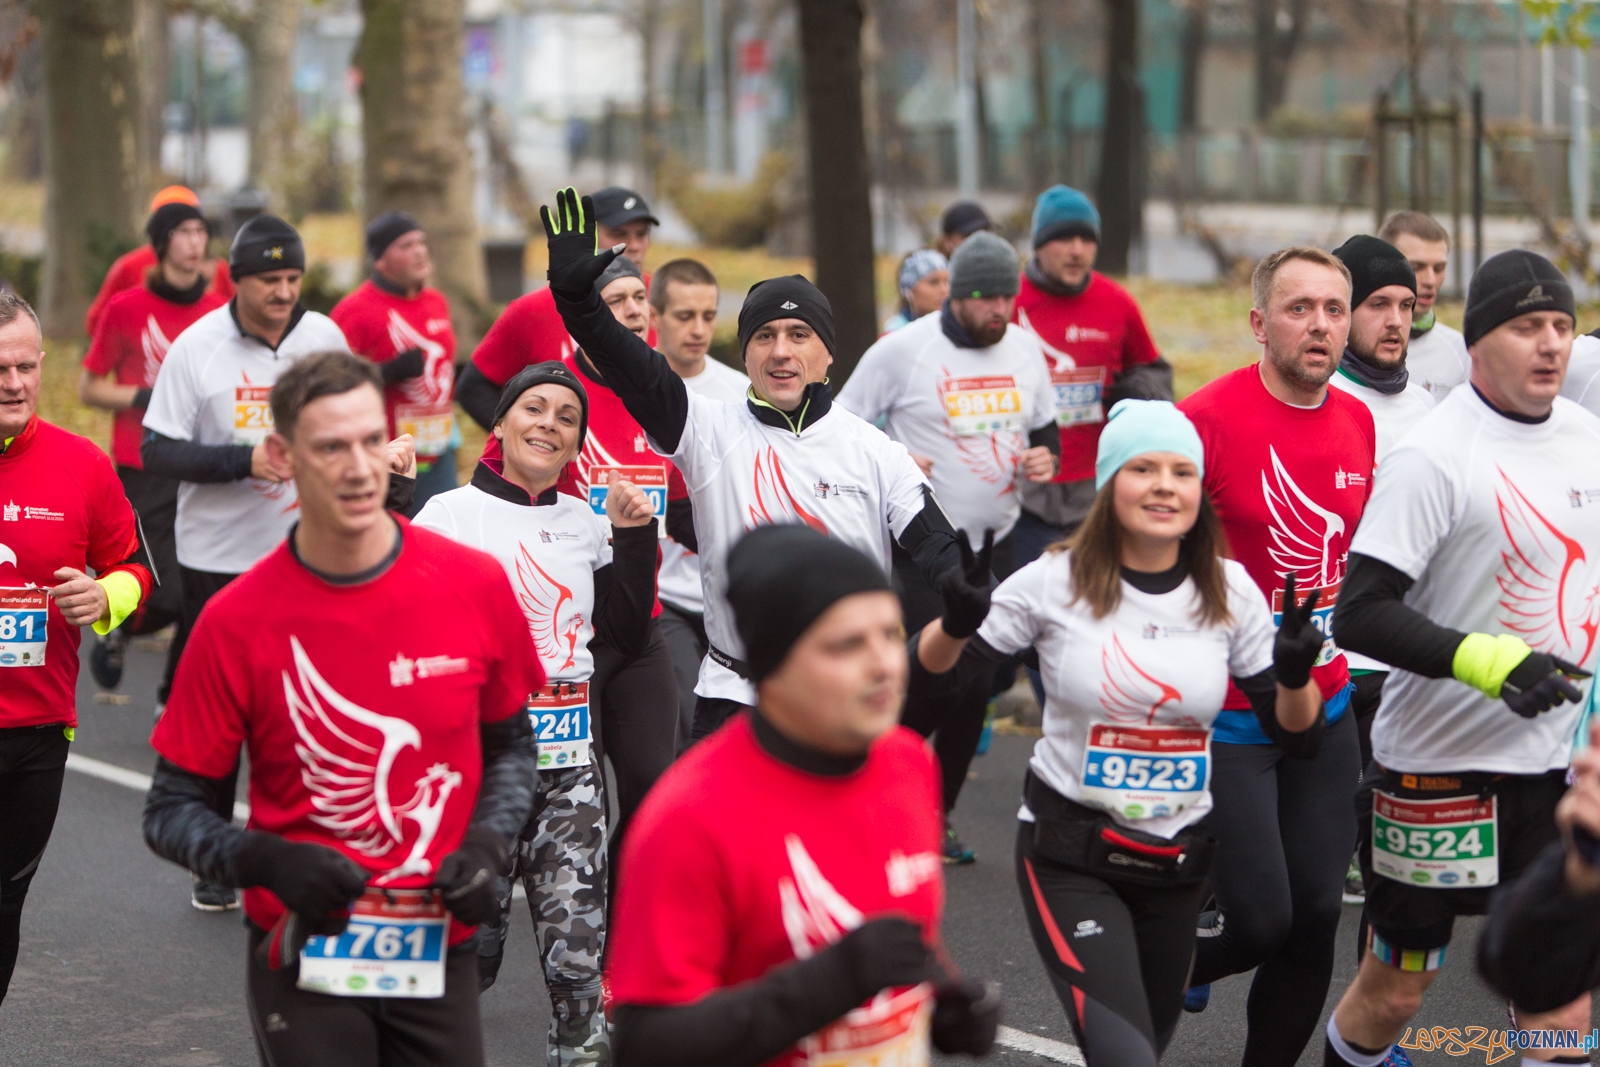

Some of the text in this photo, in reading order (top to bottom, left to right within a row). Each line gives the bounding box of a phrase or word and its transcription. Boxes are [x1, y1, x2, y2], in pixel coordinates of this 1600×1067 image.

[957, 392, 1016, 414] 9814
[23, 506, 31, 519] 1
[1, 597, 42, 605] RunPoland.org
[1087, 755, 1198, 790] E 9523
[1385, 825, 1483, 859] 9524
